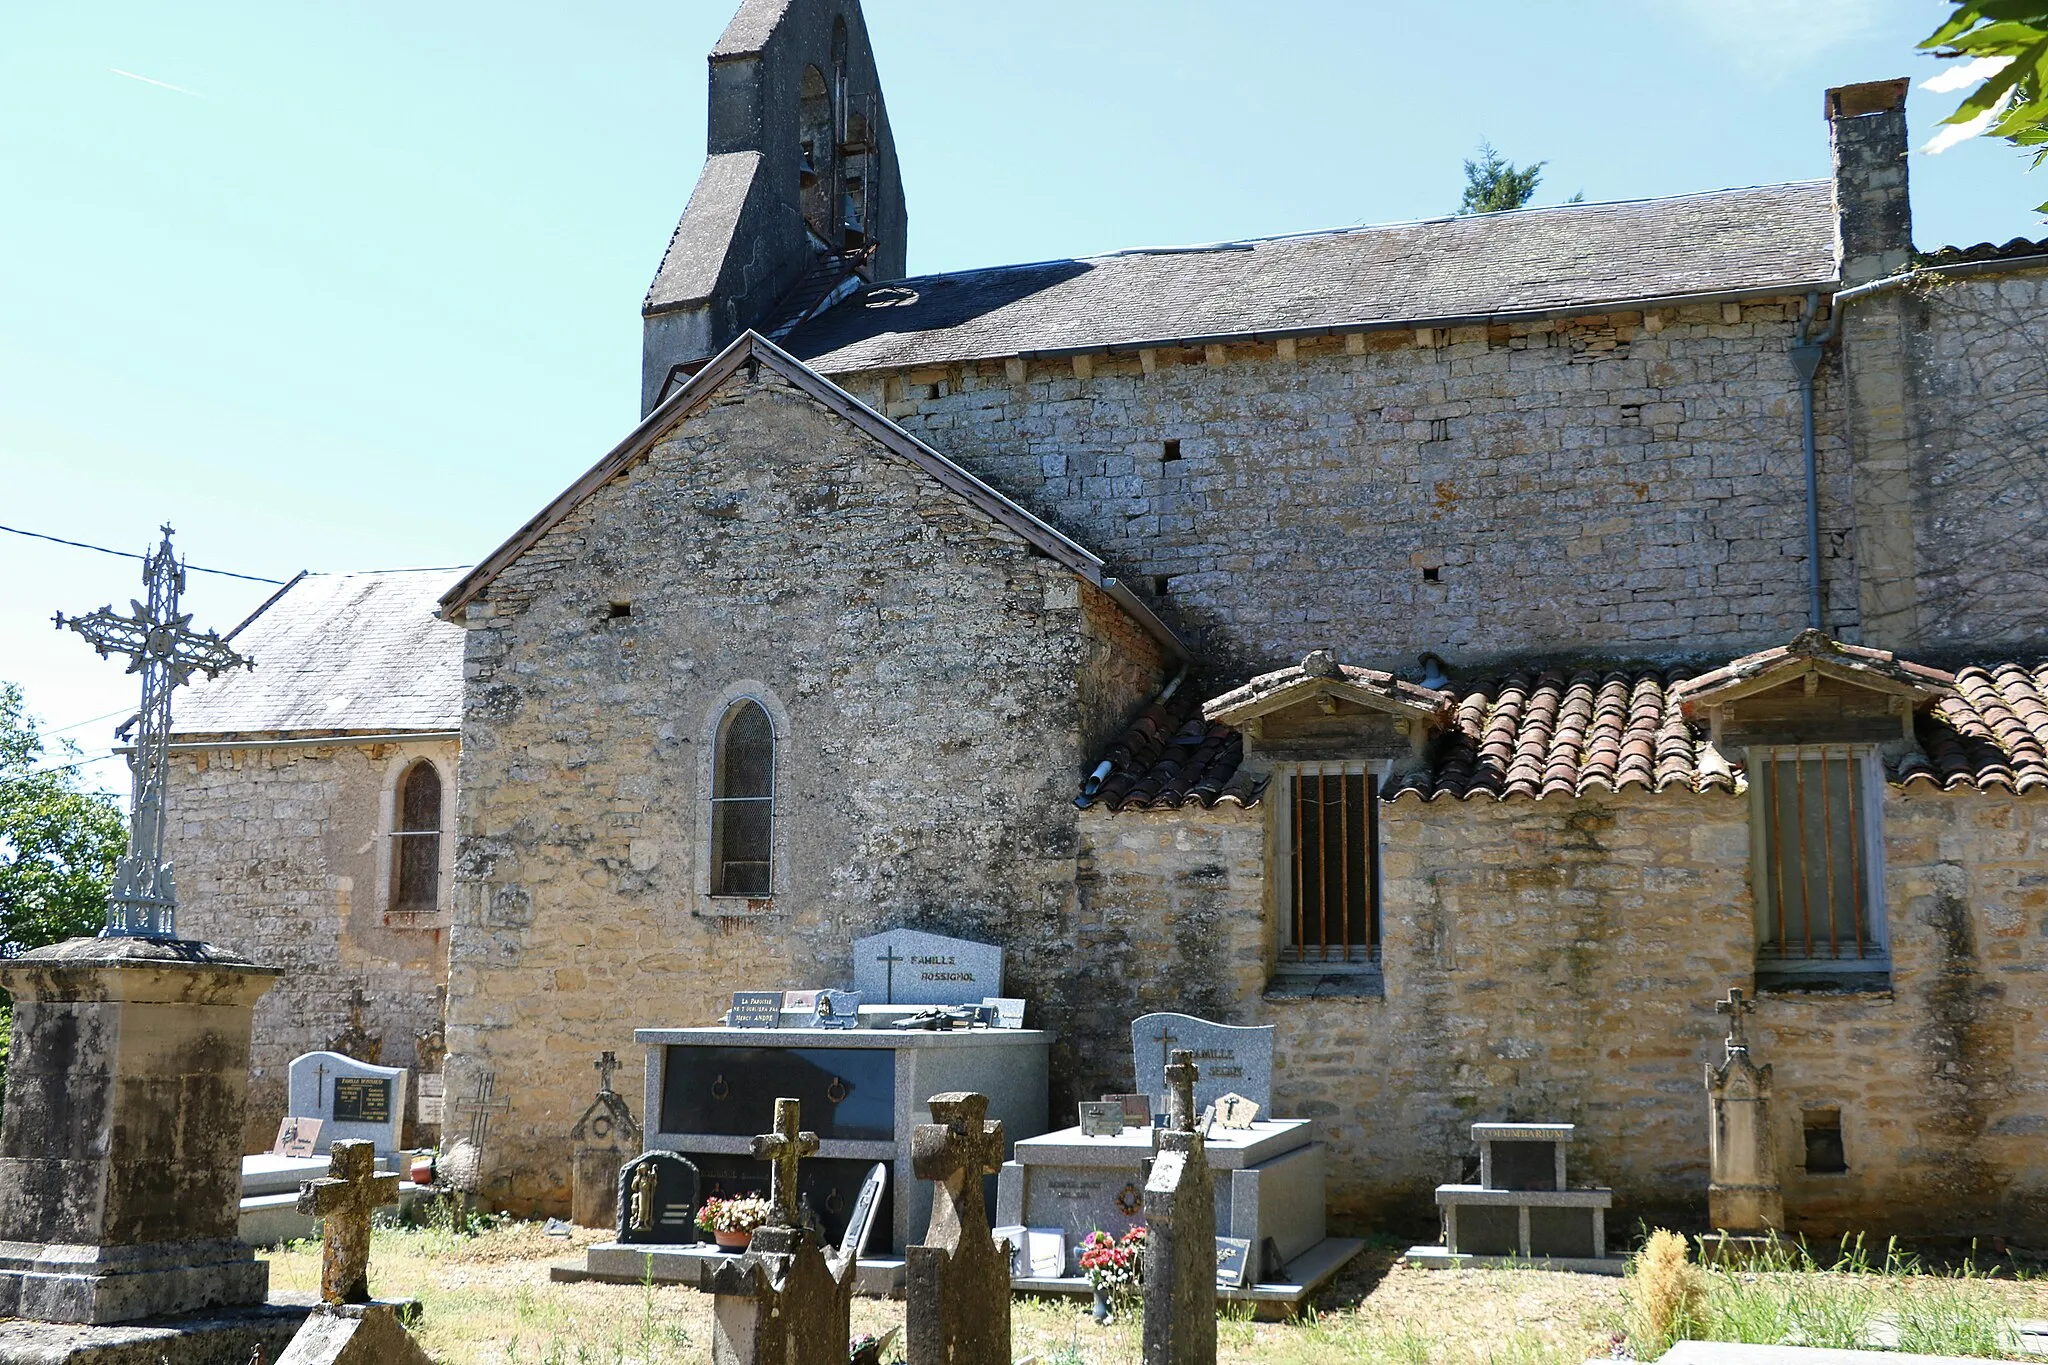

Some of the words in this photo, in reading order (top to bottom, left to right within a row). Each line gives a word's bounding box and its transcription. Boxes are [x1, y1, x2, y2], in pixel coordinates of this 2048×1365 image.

[910, 956, 956, 965] FAMILLE
[921, 973, 976, 982] ROSSIGNOL
[1193, 1049, 1234, 1059] AMILLE
[1481, 1129, 1564, 1138] COLUMBARIUM
